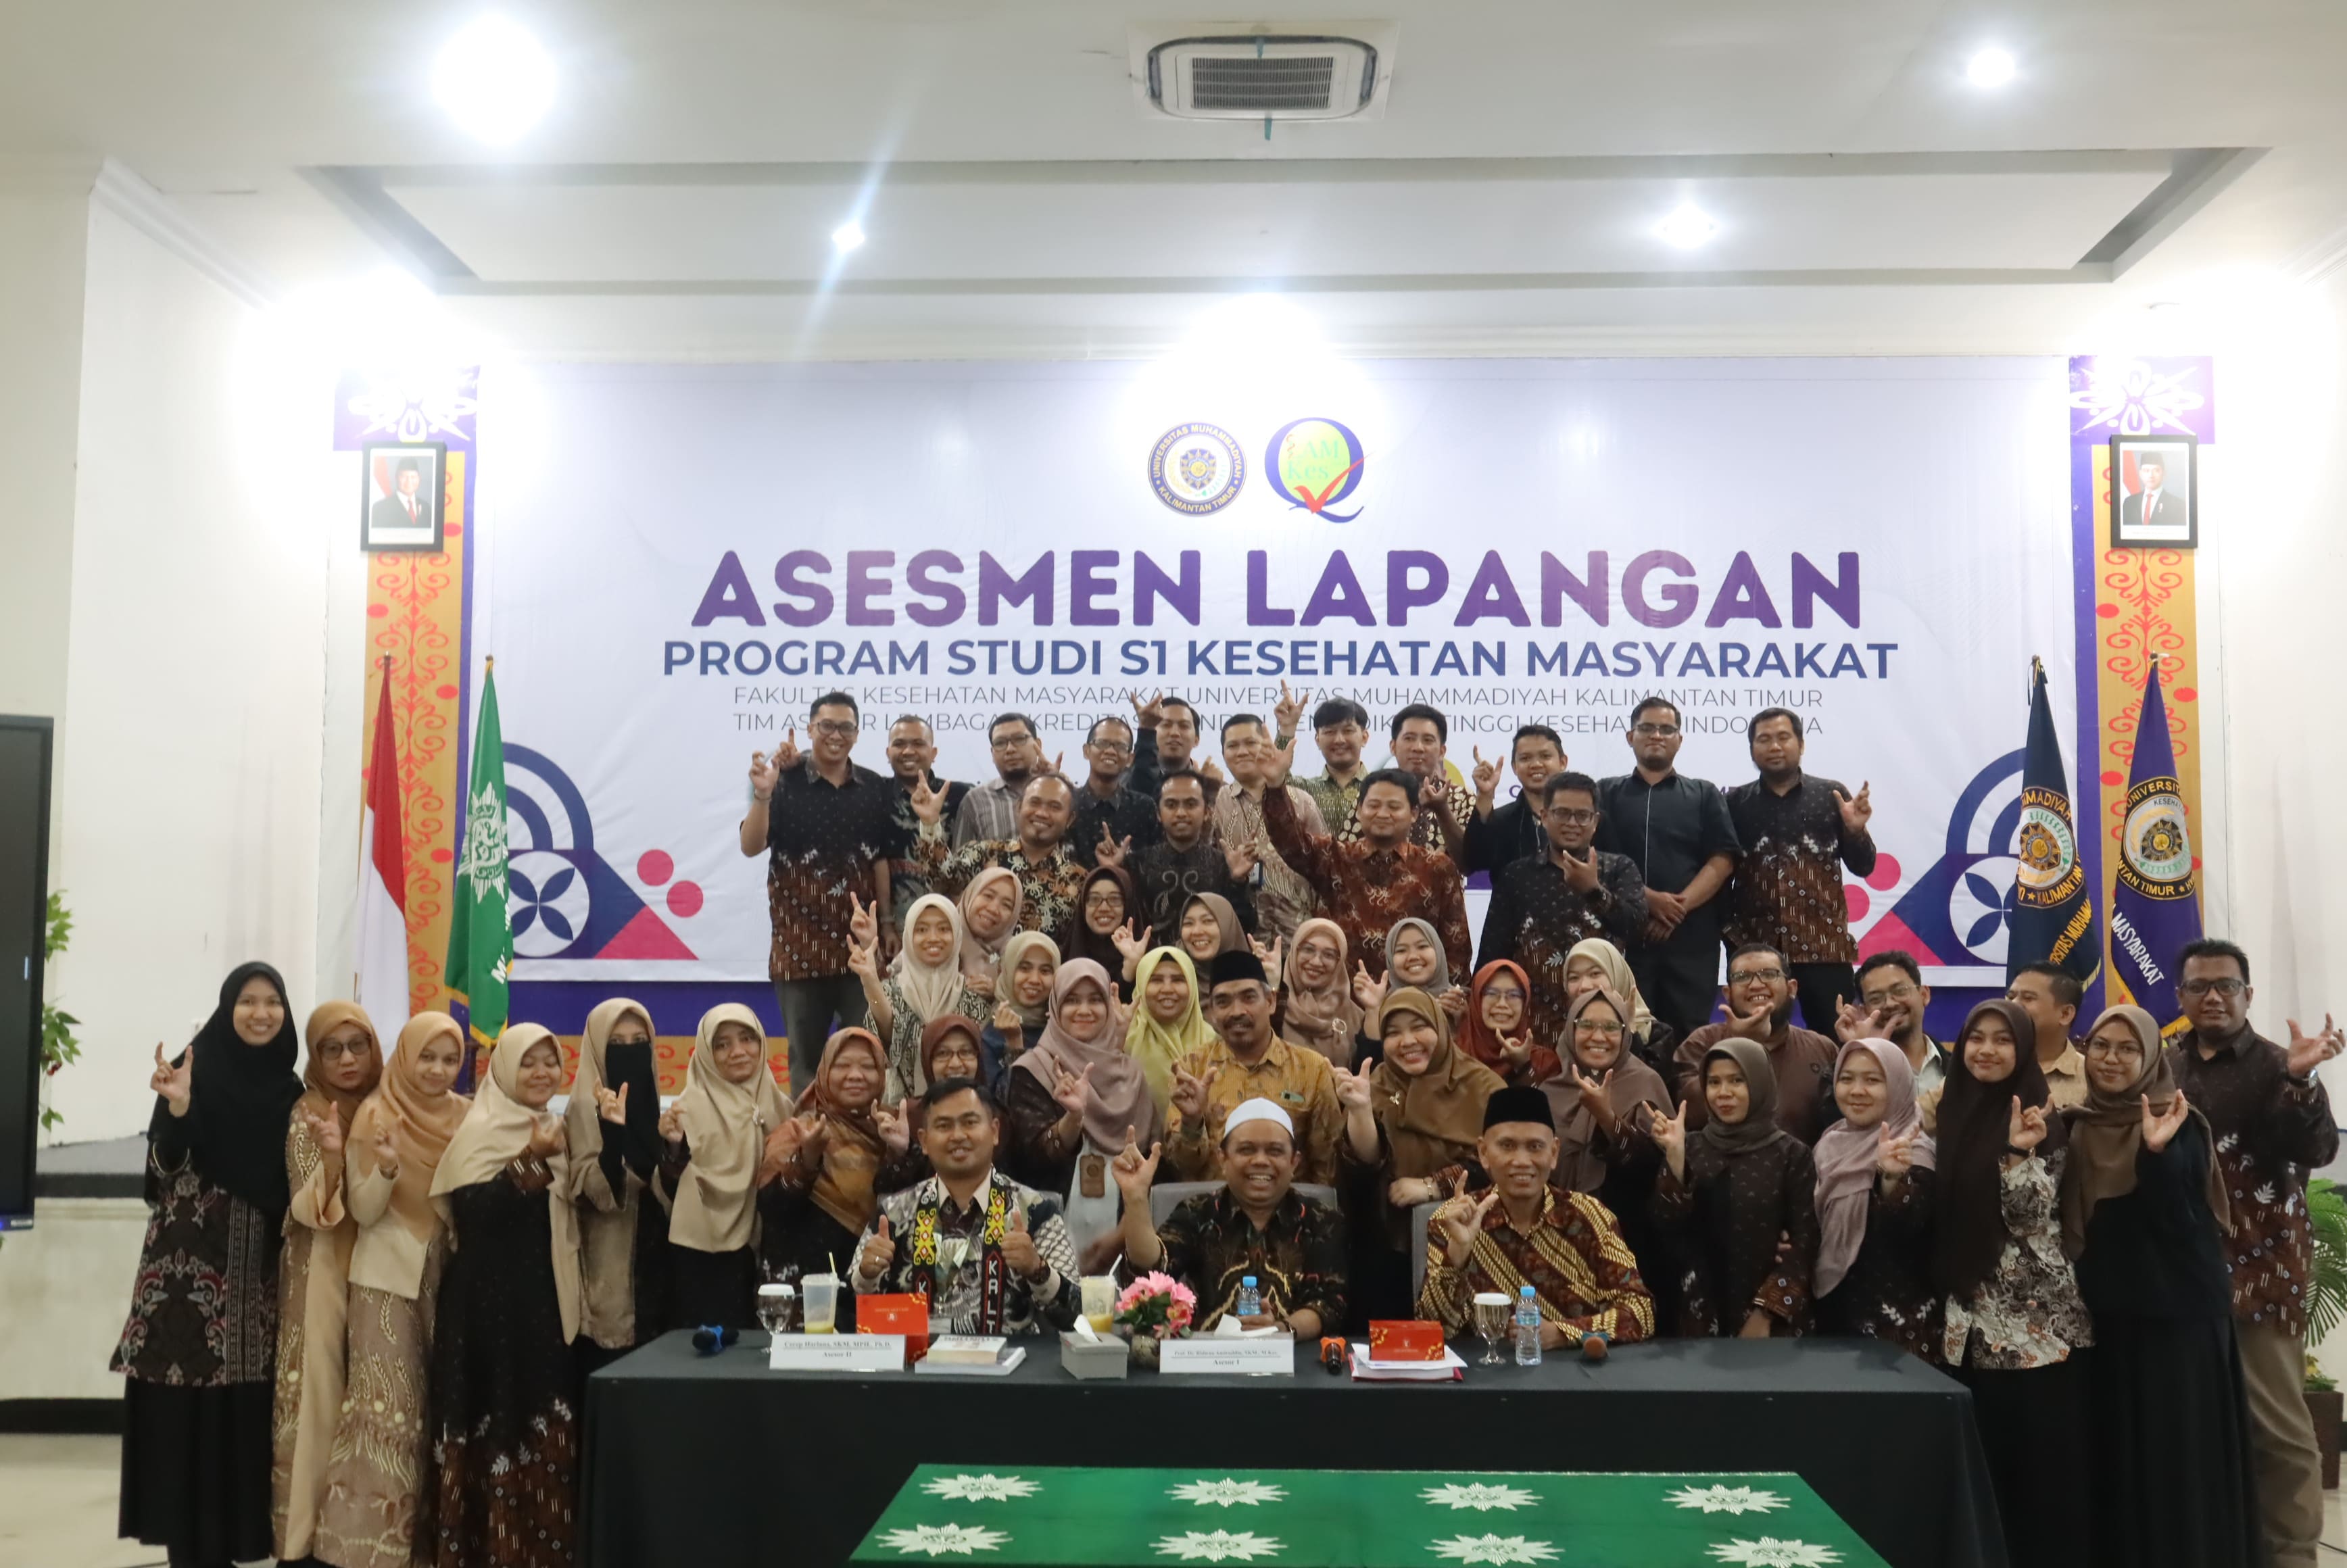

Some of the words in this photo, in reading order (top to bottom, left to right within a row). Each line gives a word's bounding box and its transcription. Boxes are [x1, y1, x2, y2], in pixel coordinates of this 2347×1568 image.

[1153, 426, 1188, 478] UNIVERSITAS
[1191, 424, 1242, 479] MUHAMMADIYAH
[1158, 486, 1211, 512] KALIMANTAN
[1212, 486, 1237, 508] TIMUR
[692, 550, 1201, 627] ASESMEN
[1247, 549, 1860, 629] LAPANGAN
[664, 640, 928, 676] PROGRAM
[947, 639, 1101, 676] STUDI
[1121, 639, 1166, 676] S1
[1188, 640, 1506, 677] KESEHATAN
[1528, 641, 1898, 679] MASYARAKAT
[735, 687, 854, 704] FAKULT
[864, 687, 1005, 704] KESEHATAN
[1353, 687, 1566, 705] MUHAMMADIYAH
[1743, 689, 1822, 707] TIMUR
[733, 713, 773, 731] TIM
[781, 713, 877, 731] ASR
[1445, 715, 1520, 732] INGGI
[1686, 716, 1822, 734] INDOIA
[2141, 881, 2175, 896] TIMUR
[2111, 911, 2164, 985] MASYARAKAT
